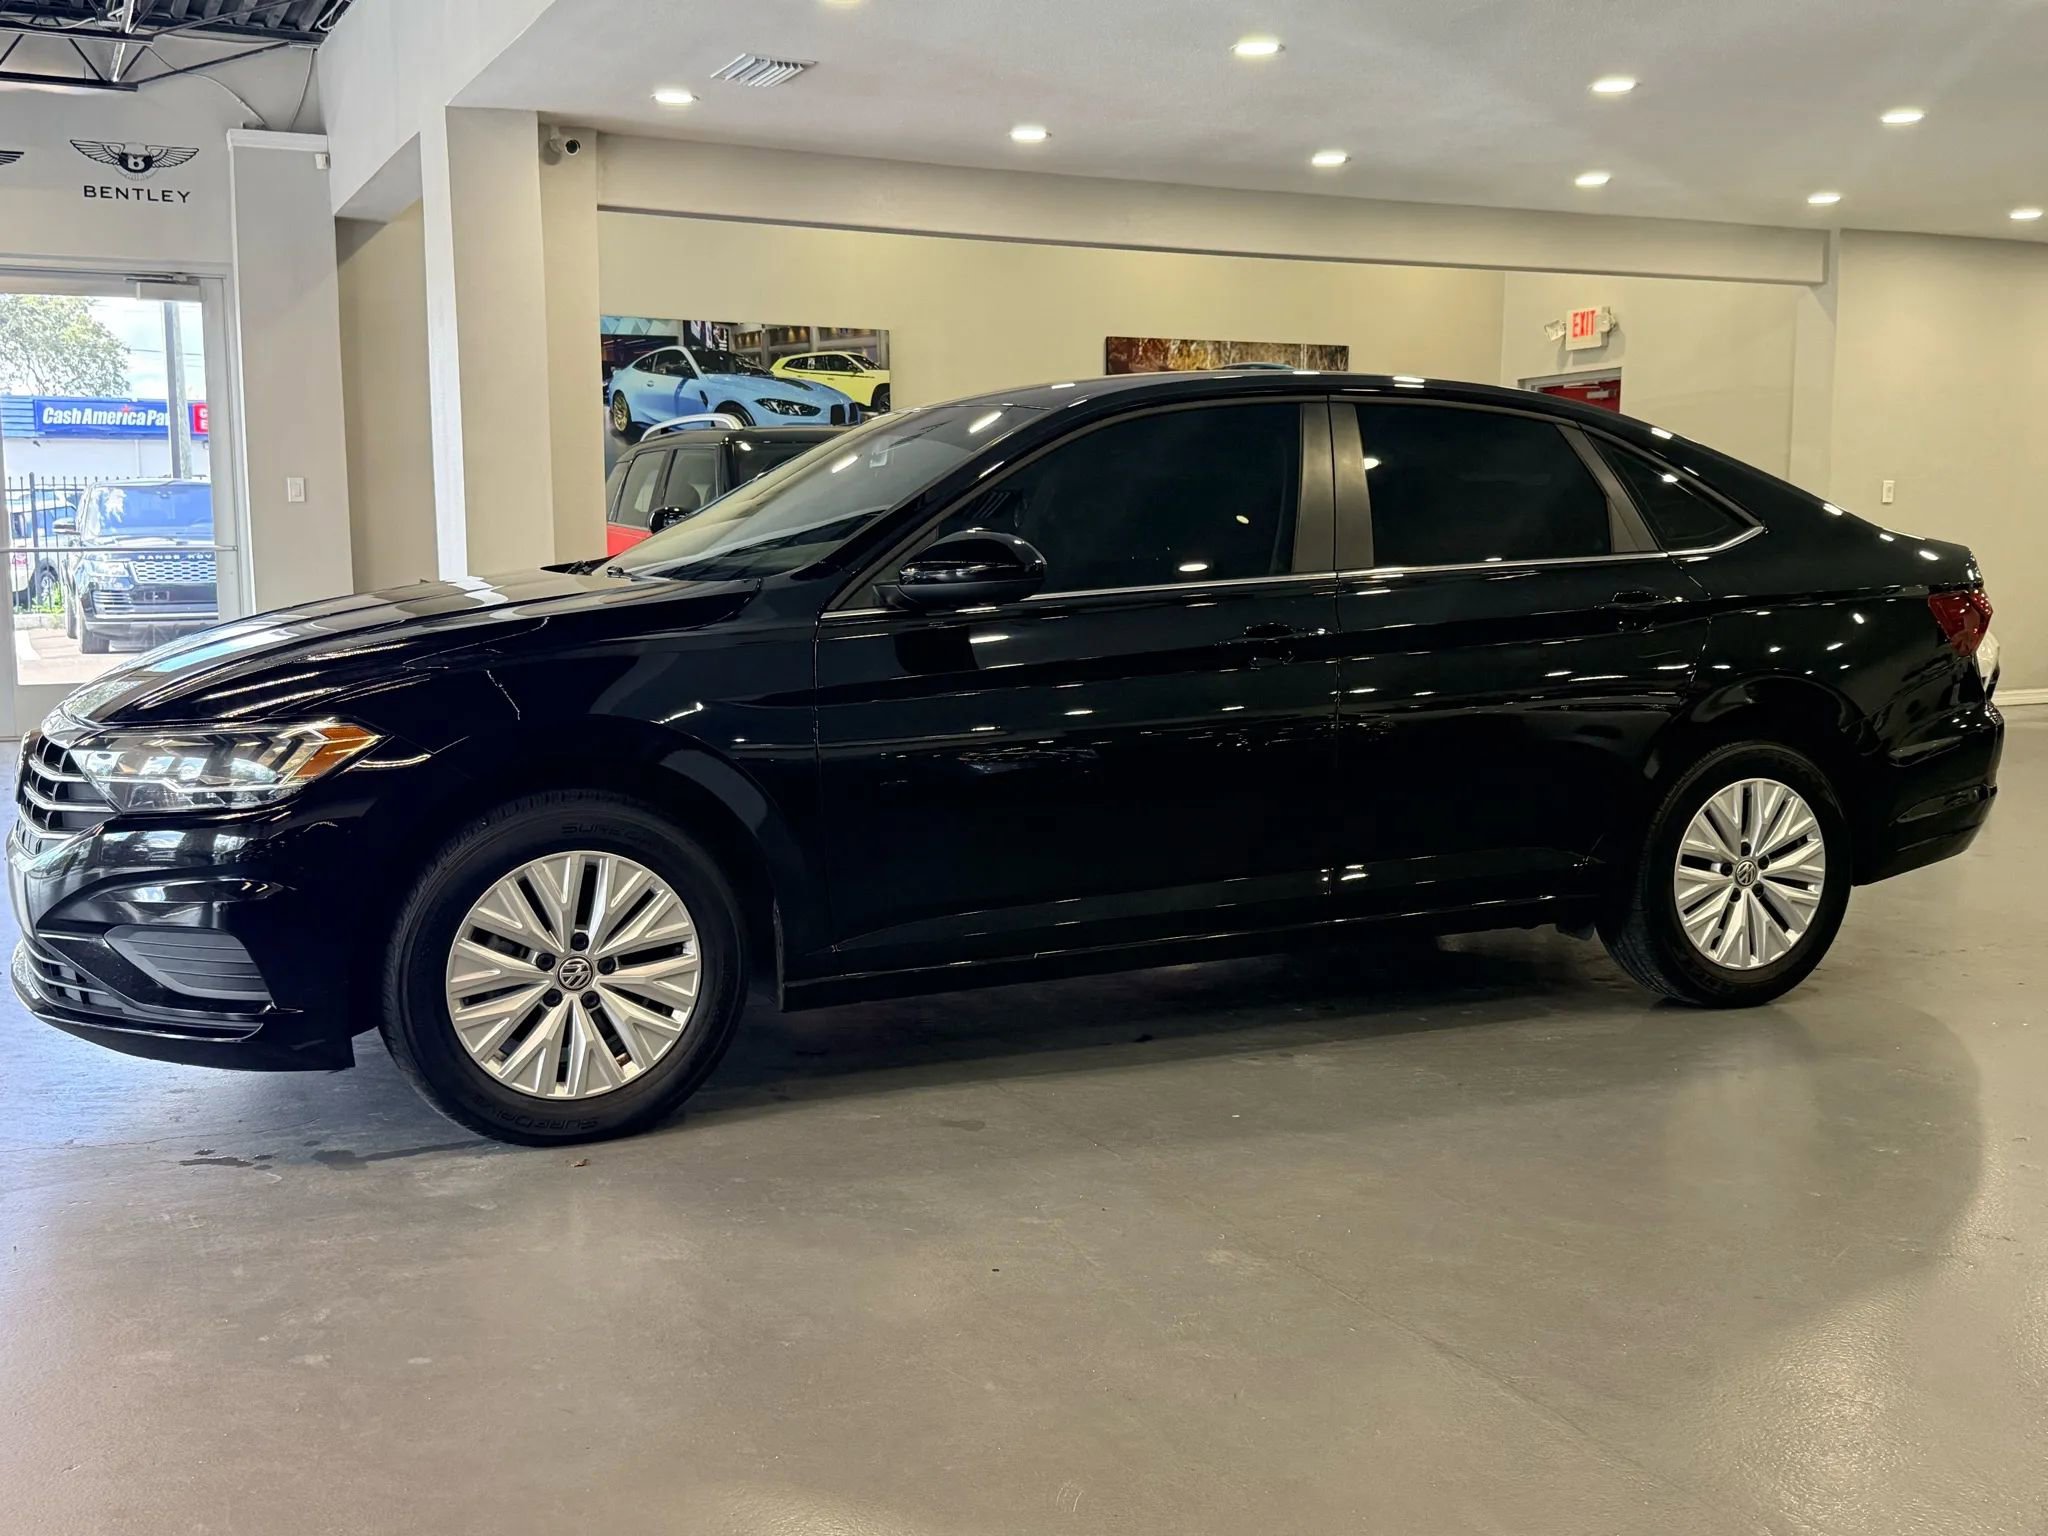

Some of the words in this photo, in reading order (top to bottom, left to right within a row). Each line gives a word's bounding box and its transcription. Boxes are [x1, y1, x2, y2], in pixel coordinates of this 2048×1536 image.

[83, 185, 191, 203] BENTLEY
[1572, 309, 1596, 338] EXIT
[187, 553, 212, 561] ROV
